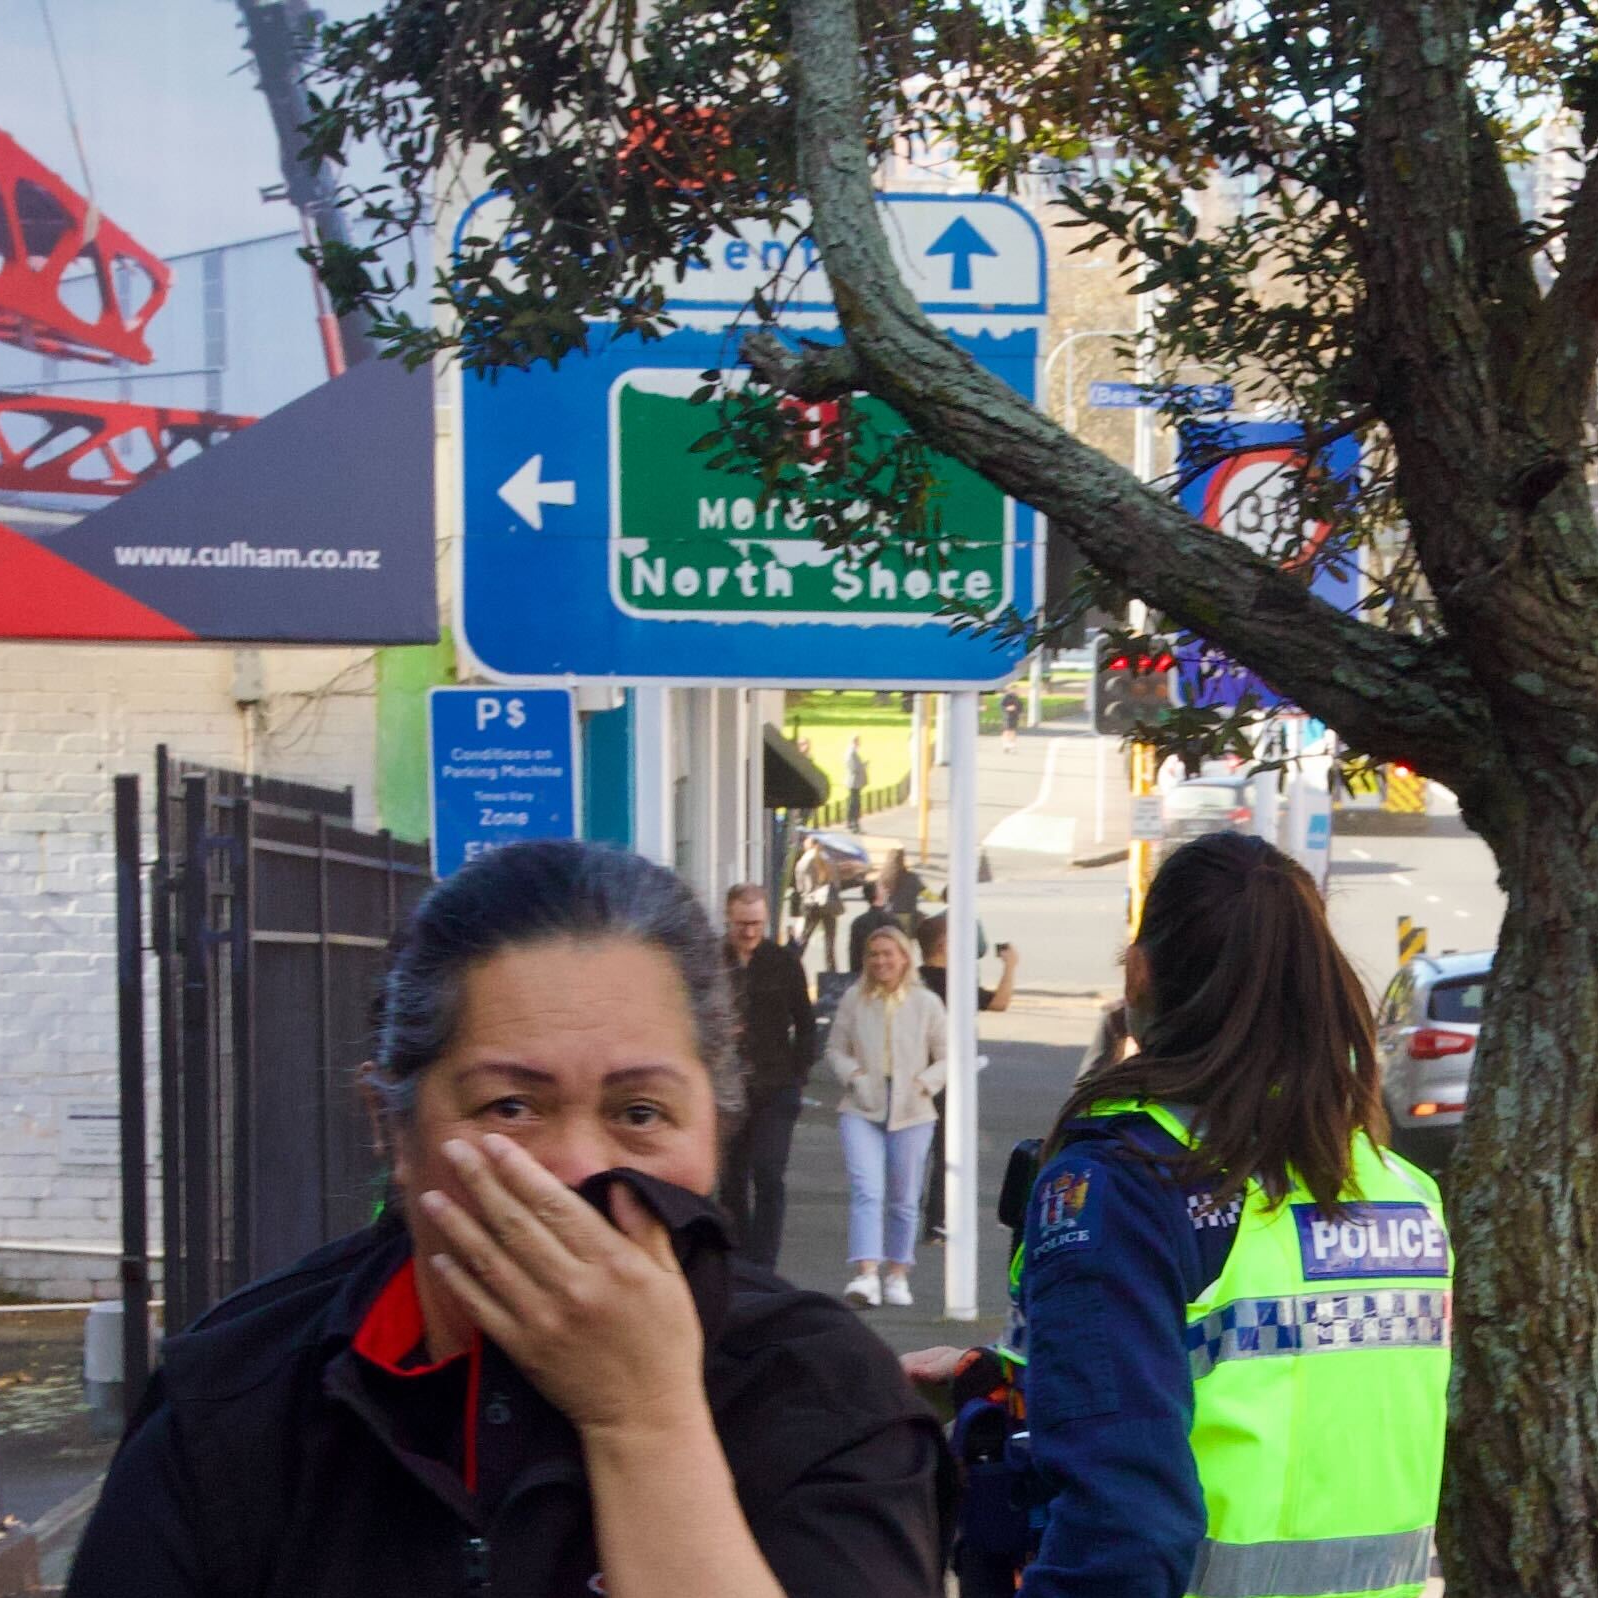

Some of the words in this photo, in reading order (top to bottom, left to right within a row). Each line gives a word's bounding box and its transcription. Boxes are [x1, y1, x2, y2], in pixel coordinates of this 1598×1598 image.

[115, 541, 380, 570] www.culham.co.nz
[630, 556, 795, 599] North
[831, 560, 993, 602] Shore
[450, 747, 532, 762] Conditions
[534, 749, 554, 761] on
[441, 765, 499, 781] Parking
[499, 764, 564, 778] Machine
[479, 808, 530, 827] Zone
[1032, 1229, 1091, 1260] POLICE
[1310, 1218, 1444, 1260] POLICE
